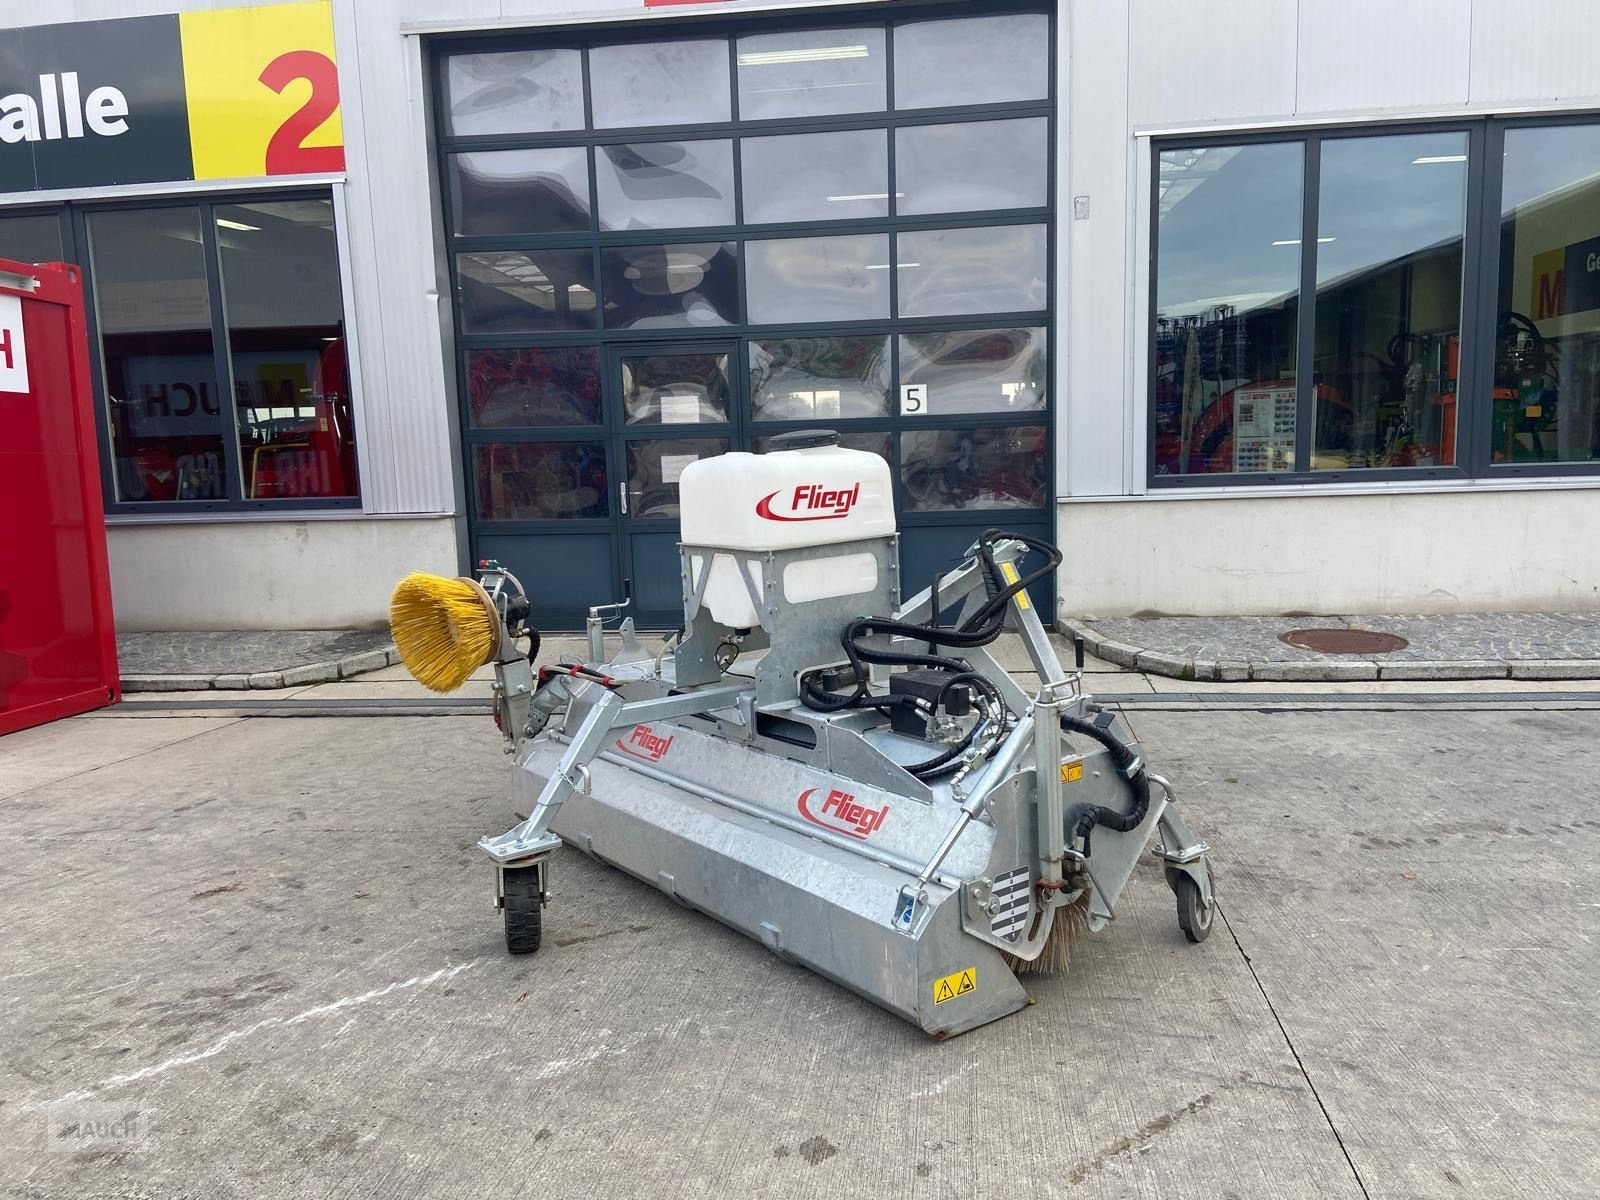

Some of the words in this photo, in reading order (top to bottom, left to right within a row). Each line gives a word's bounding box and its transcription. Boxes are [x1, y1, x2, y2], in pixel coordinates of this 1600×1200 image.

[258, 50, 346, 176] 2
[1539, 269, 1565, 320] M
[906, 388, 921, 412] 5
[791, 482, 860, 513] Fliegl
[630, 724, 674, 759] Fliegl
[821, 789, 890, 835] Fliegl
